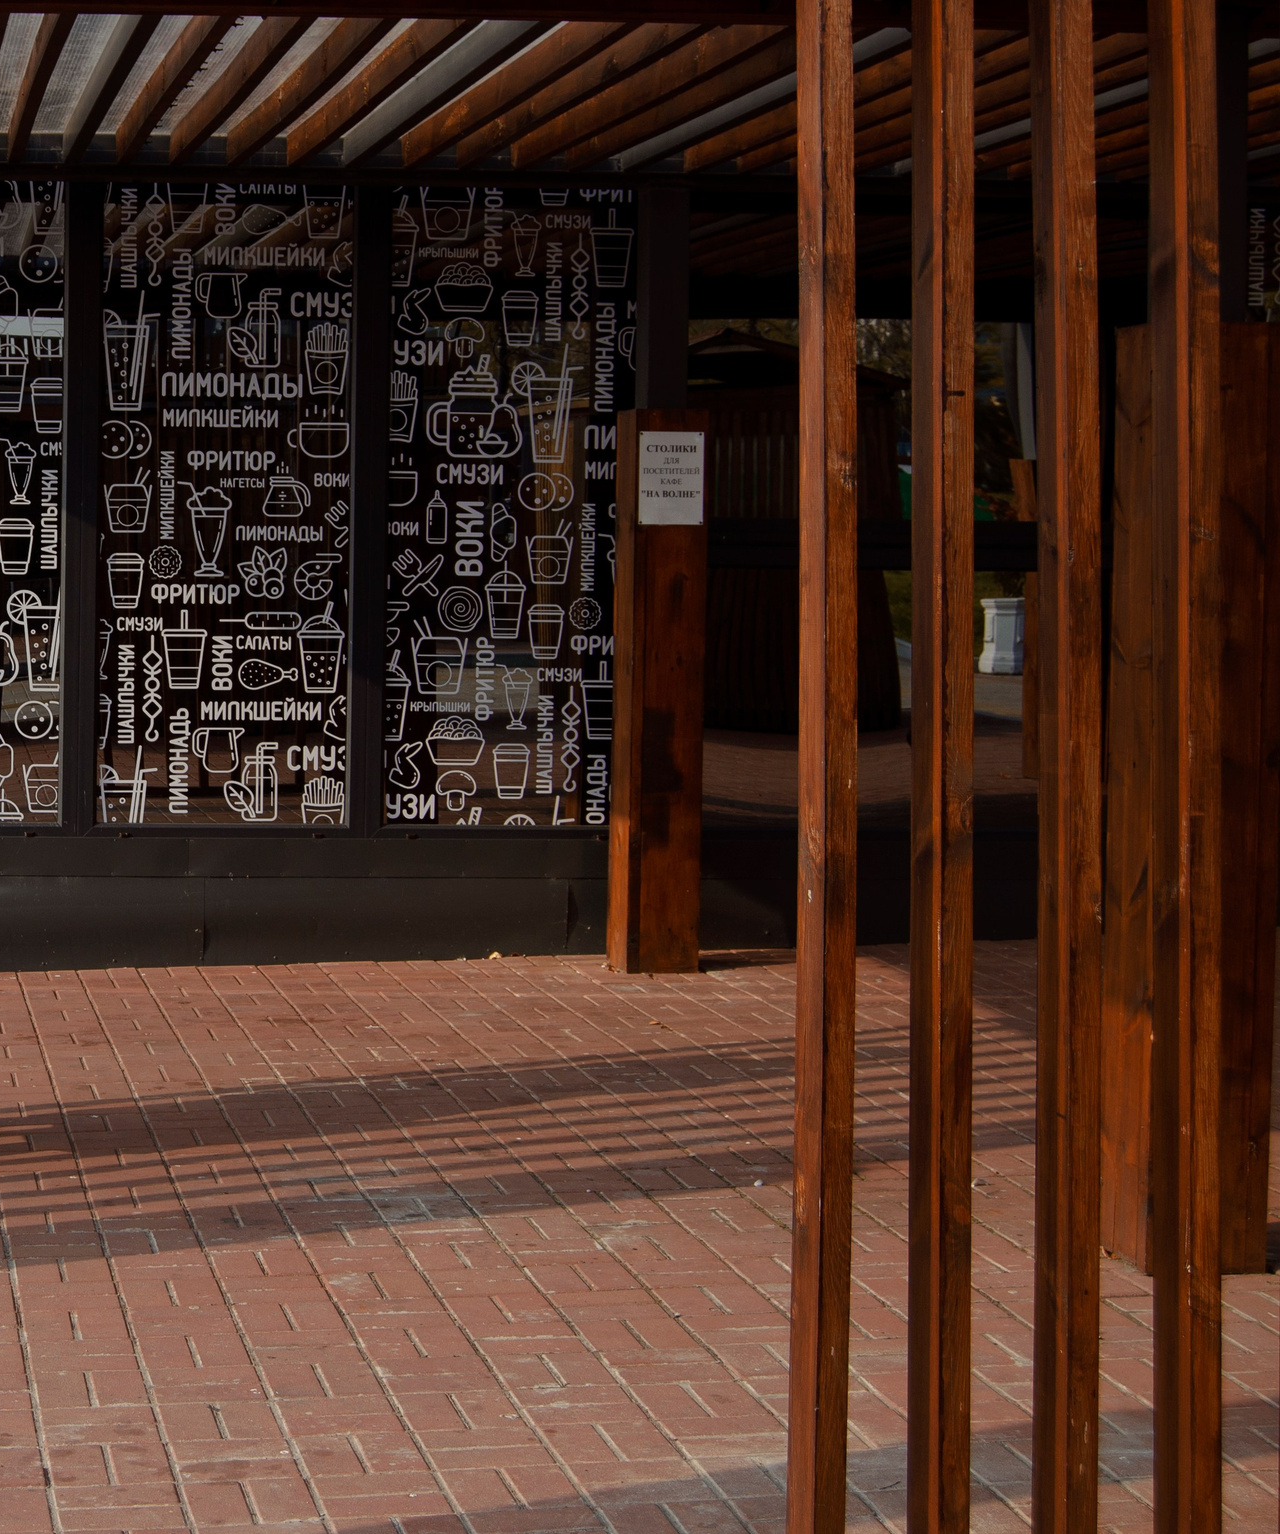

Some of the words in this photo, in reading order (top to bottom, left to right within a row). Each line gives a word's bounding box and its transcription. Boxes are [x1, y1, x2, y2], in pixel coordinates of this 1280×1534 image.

[546, 214, 591, 229] СМУЗИ
[394, 340, 444, 366] УЗИ
[162, 372, 303, 400] ЛИМОНАДЫ
[163, 406, 279, 428] МИЛКШЕЙКИ
[647, 445, 696, 453] СТОЛИКИ
[187, 450, 275, 471] ФРИТЮР
[220, 478, 265, 488] НАГЕТСЫ
[314, 473, 350, 487] ВОКИ
[436, 464, 503, 485] СМУЗИ
[455, 501, 484, 576] ВОКИ
[151, 584, 240, 605] ФРИТЮР
[117, 617, 163, 631] СМУЗИ
[236, 635, 291, 651] САЛАТЫ
[212, 635, 233, 691] ВОКИ
[475, 636, 495, 721] ФРИТЮР
[537, 668, 582, 681] СМУЗИ
[200, 698, 322, 721] МИЛКШЕЙКИ
[386, 793, 436, 820] УЗИ
